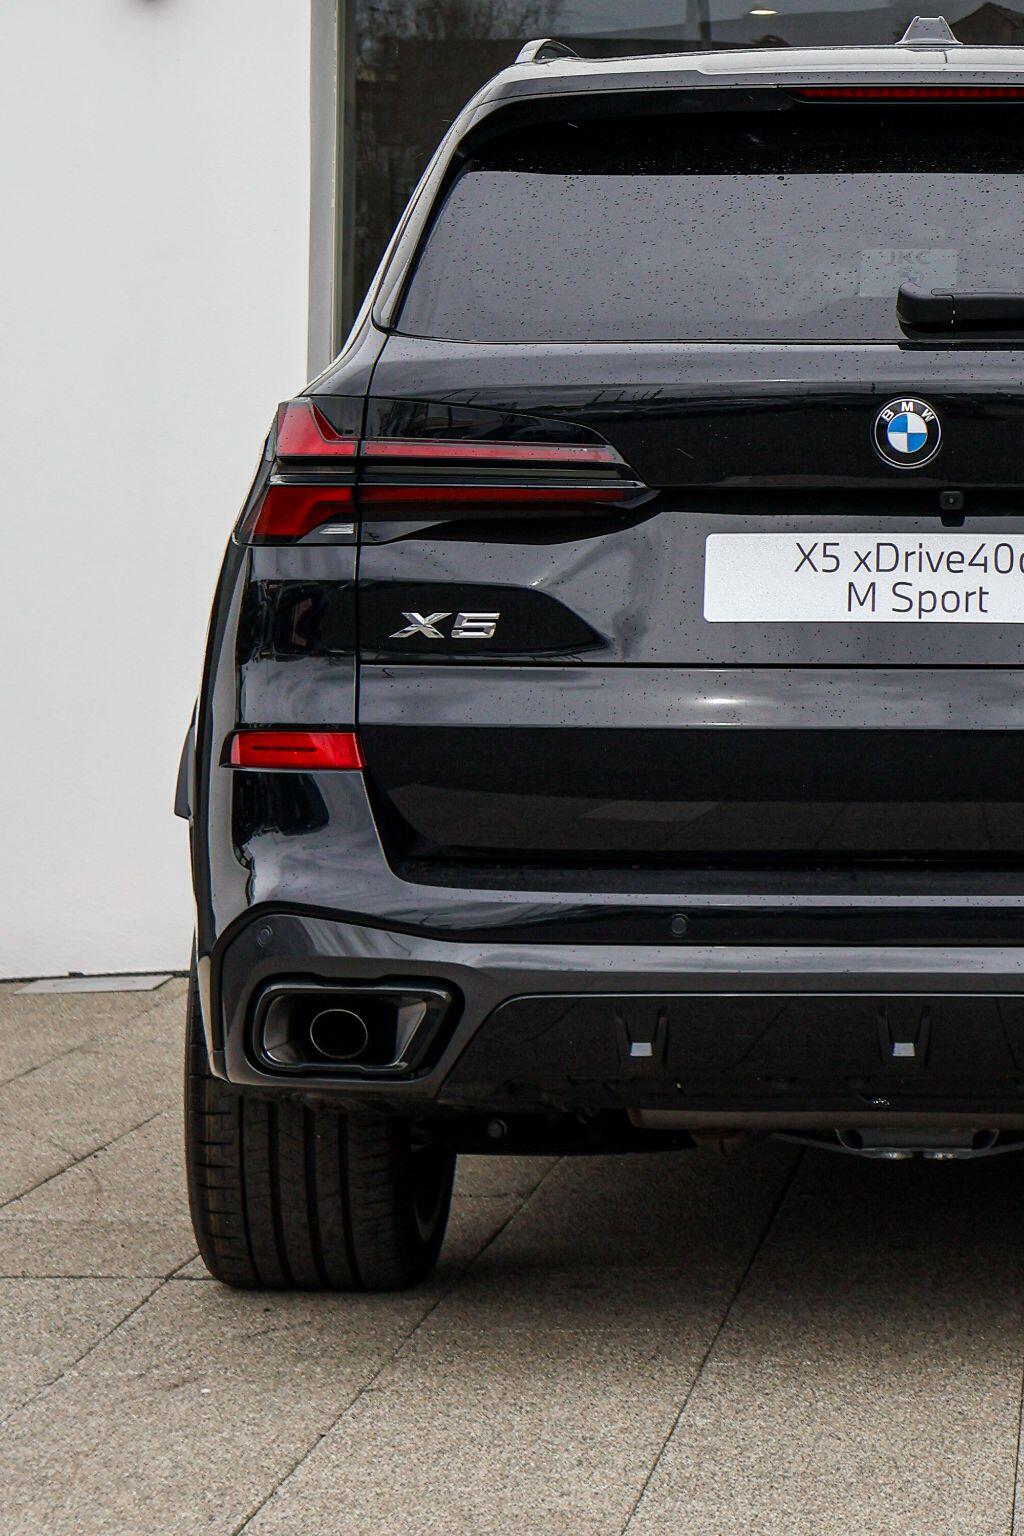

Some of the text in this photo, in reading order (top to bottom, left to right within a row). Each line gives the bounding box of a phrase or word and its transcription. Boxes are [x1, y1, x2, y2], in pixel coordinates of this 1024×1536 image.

[881, 401, 935, 423] BMW
[794, 542, 840, 573] X5
[847, 581, 990, 619] M Sport
[389, 612, 501, 639] X5
